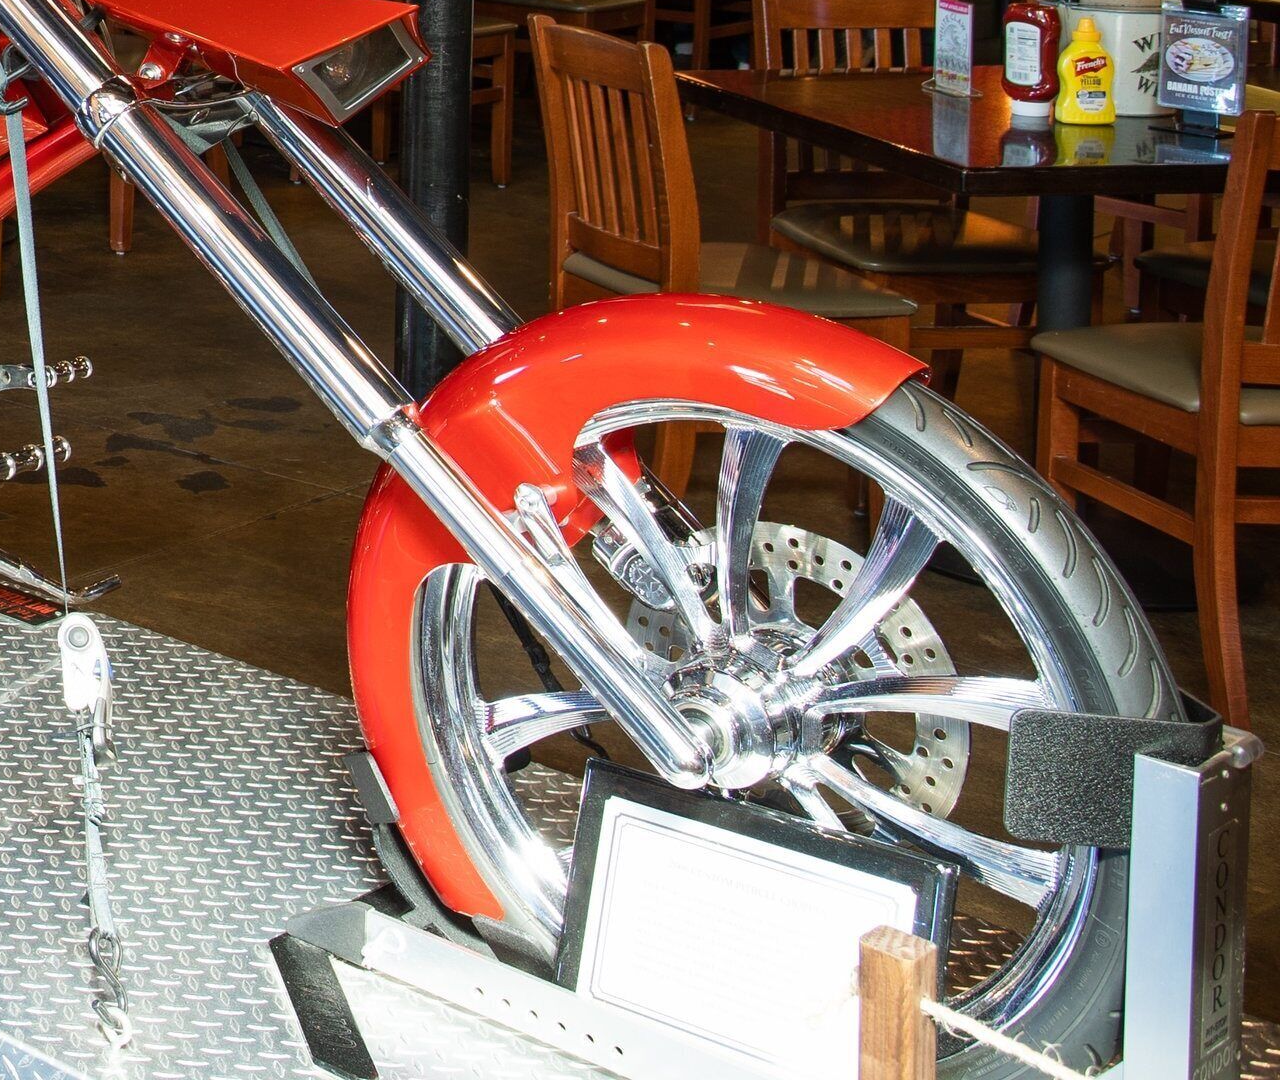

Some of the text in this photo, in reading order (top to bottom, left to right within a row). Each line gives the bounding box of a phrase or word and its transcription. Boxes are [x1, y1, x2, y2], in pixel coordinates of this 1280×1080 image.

[1169, 23, 1184, 34] Eat
[1076, 57, 1106, 72] French's
[1166, 81, 1199, 94] BANANA
[1210, 829, 1230, 1015] CONDOR
